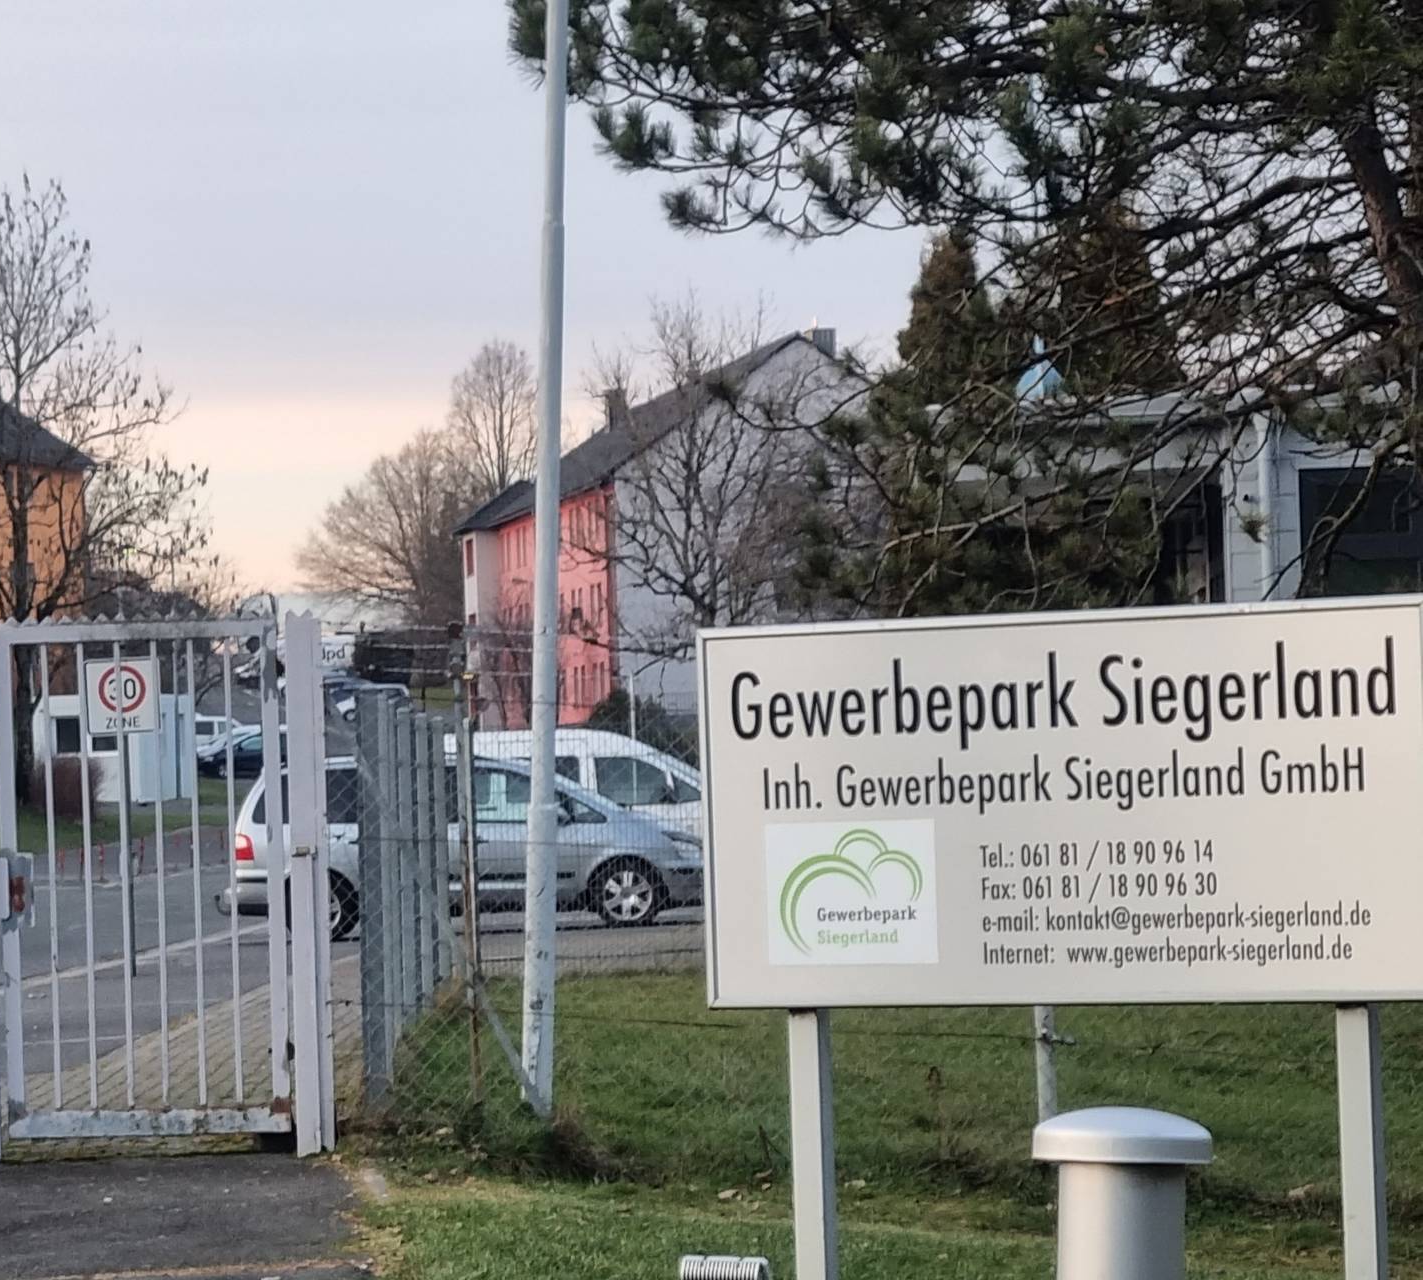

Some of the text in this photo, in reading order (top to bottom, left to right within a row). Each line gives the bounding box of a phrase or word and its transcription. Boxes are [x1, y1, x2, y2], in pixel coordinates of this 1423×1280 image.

[108, 678, 136, 700] 30
[730, 635, 1397, 749] Gewerbepark Siegerland
[762, 743, 1366, 815] Inh. Gewerbepark Siegerland GmbH
[979, 839, 1214, 872] Tel.: 061 81 / 18 90 96 14
[981, 872, 1218, 904] Fax: 061 81 / 18 90 96 30
[817, 906, 917, 925] Gewerbepark
[982, 899, 1372, 936] e-mail: kontakt@gewerbepark-siegerland.de
[817, 928, 899, 948] Siegerland
[983, 932, 1353, 968] Internet: www.gewerbepark-siegerland.de
